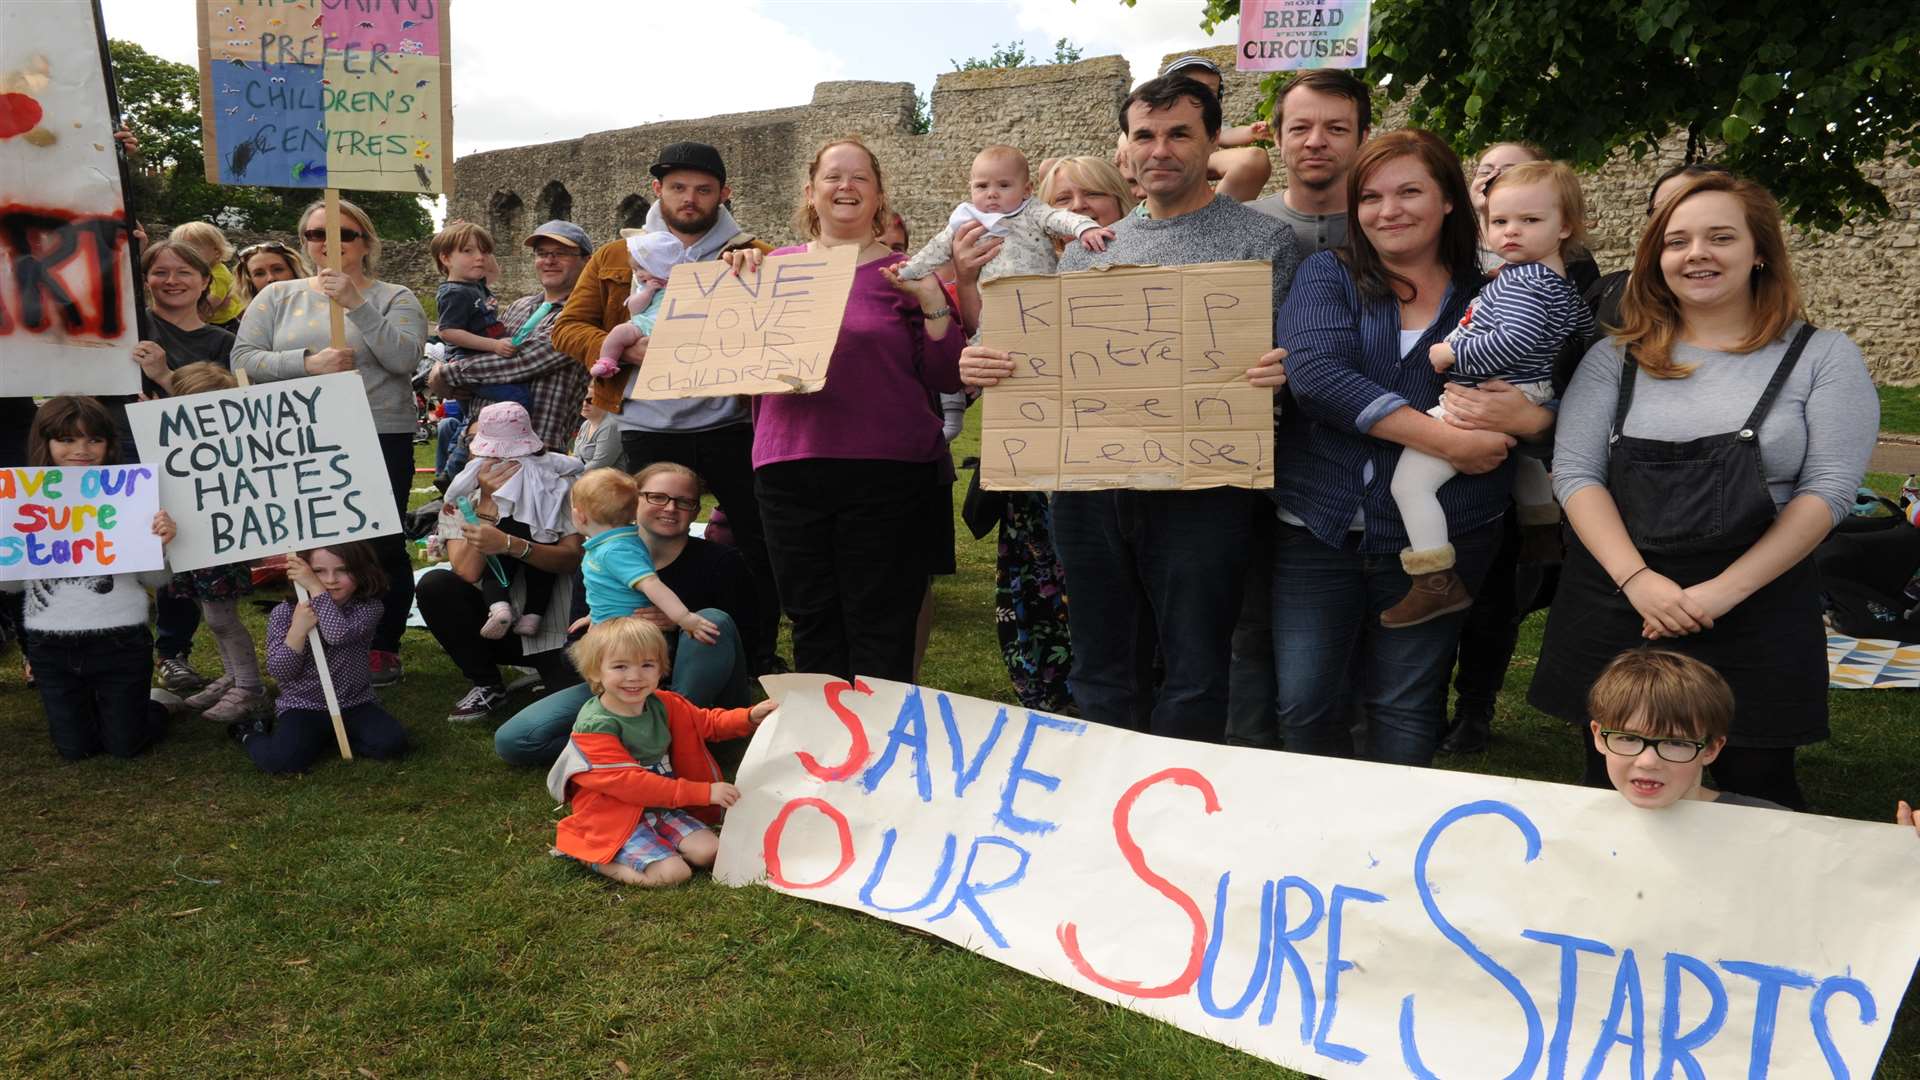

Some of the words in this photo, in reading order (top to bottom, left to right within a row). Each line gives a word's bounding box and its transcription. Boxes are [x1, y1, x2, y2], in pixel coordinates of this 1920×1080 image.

[1264, 8, 1344, 28] BREAD
[259, 32, 397, 75] PREFER
[1242, 37, 1359, 60] CIRCUSES
[246, 79, 415, 114] CHILDREN'S
[254, 124, 409, 157] CENTRES
[693, 262, 828, 298] WE
[666, 298, 815, 331] LOVE
[1016, 287, 1240, 348] KEEP
[674, 331, 796, 365] OUR
[159, 386, 322, 447] MEDWAY
[1019, 397, 1233, 432] open
[165, 425, 343, 477] COUNCIL
[80, 468, 152, 498] our
[195, 453, 353, 511] HATES
[211, 490, 380, 554] BABIES.
[795, 679, 1089, 836] SAVE
[763, 797, 1032, 949] OUR
[1056, 767, 1390, 1066] SURE
[1398, 799, 1879, 1080] STARTS
